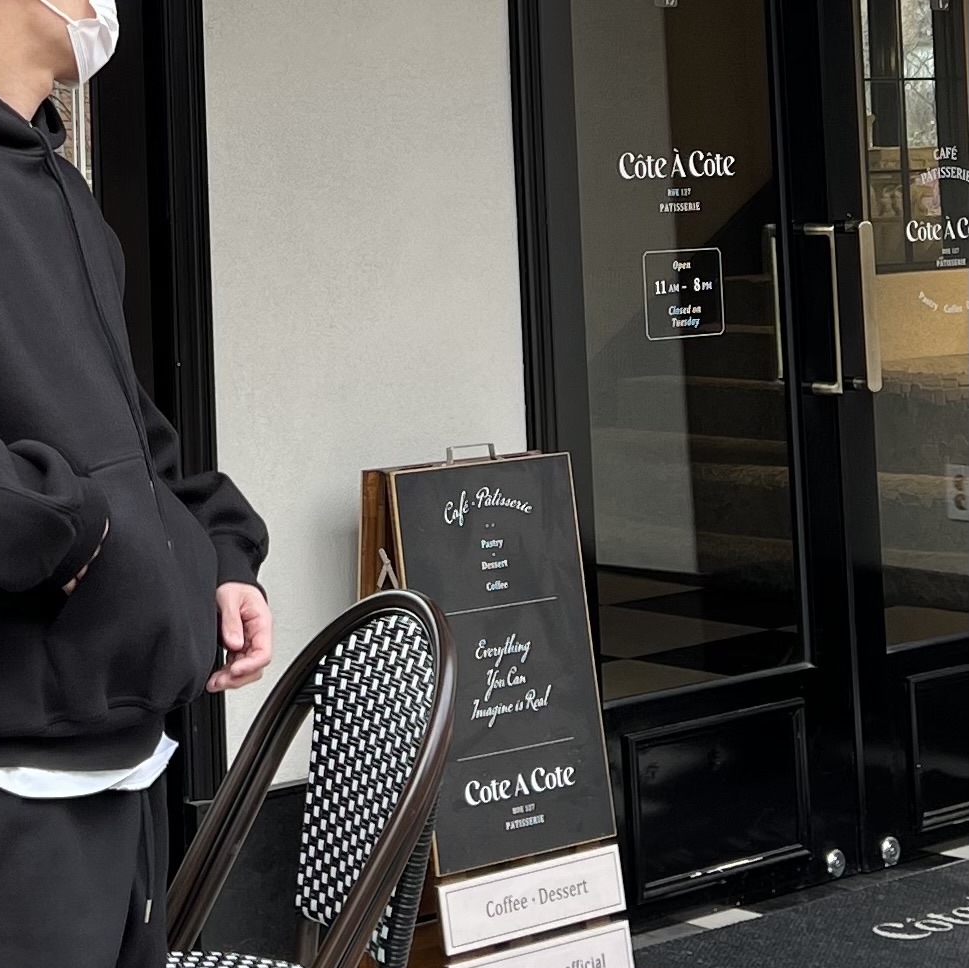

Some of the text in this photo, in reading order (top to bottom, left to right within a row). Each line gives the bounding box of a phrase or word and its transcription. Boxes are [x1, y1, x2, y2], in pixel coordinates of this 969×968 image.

[933, 146, 958, 161] CAFÉ
[619, 147, 735, 180] Côte À Côte
[906, 220, 942, 243] Côte
[957, 217, 969, 239] C
[672, 260, 691, 272] Open
[655, 280, 667, 295] 11
[693, 277, 701, 292] 8
[668, 304, 692, 316] Closed
[480, 539, 504, 549] Pastry
[481, 559, 509, 571] Dessert
[486, 580, 509, 592] Coffee
[475, 633, 531, 668] Everything
[484, 665, 527, 702] You Can
[470, 684, 552, 728] Imagine is Real
[486, 879, 589, 918] Coffee Dessert
